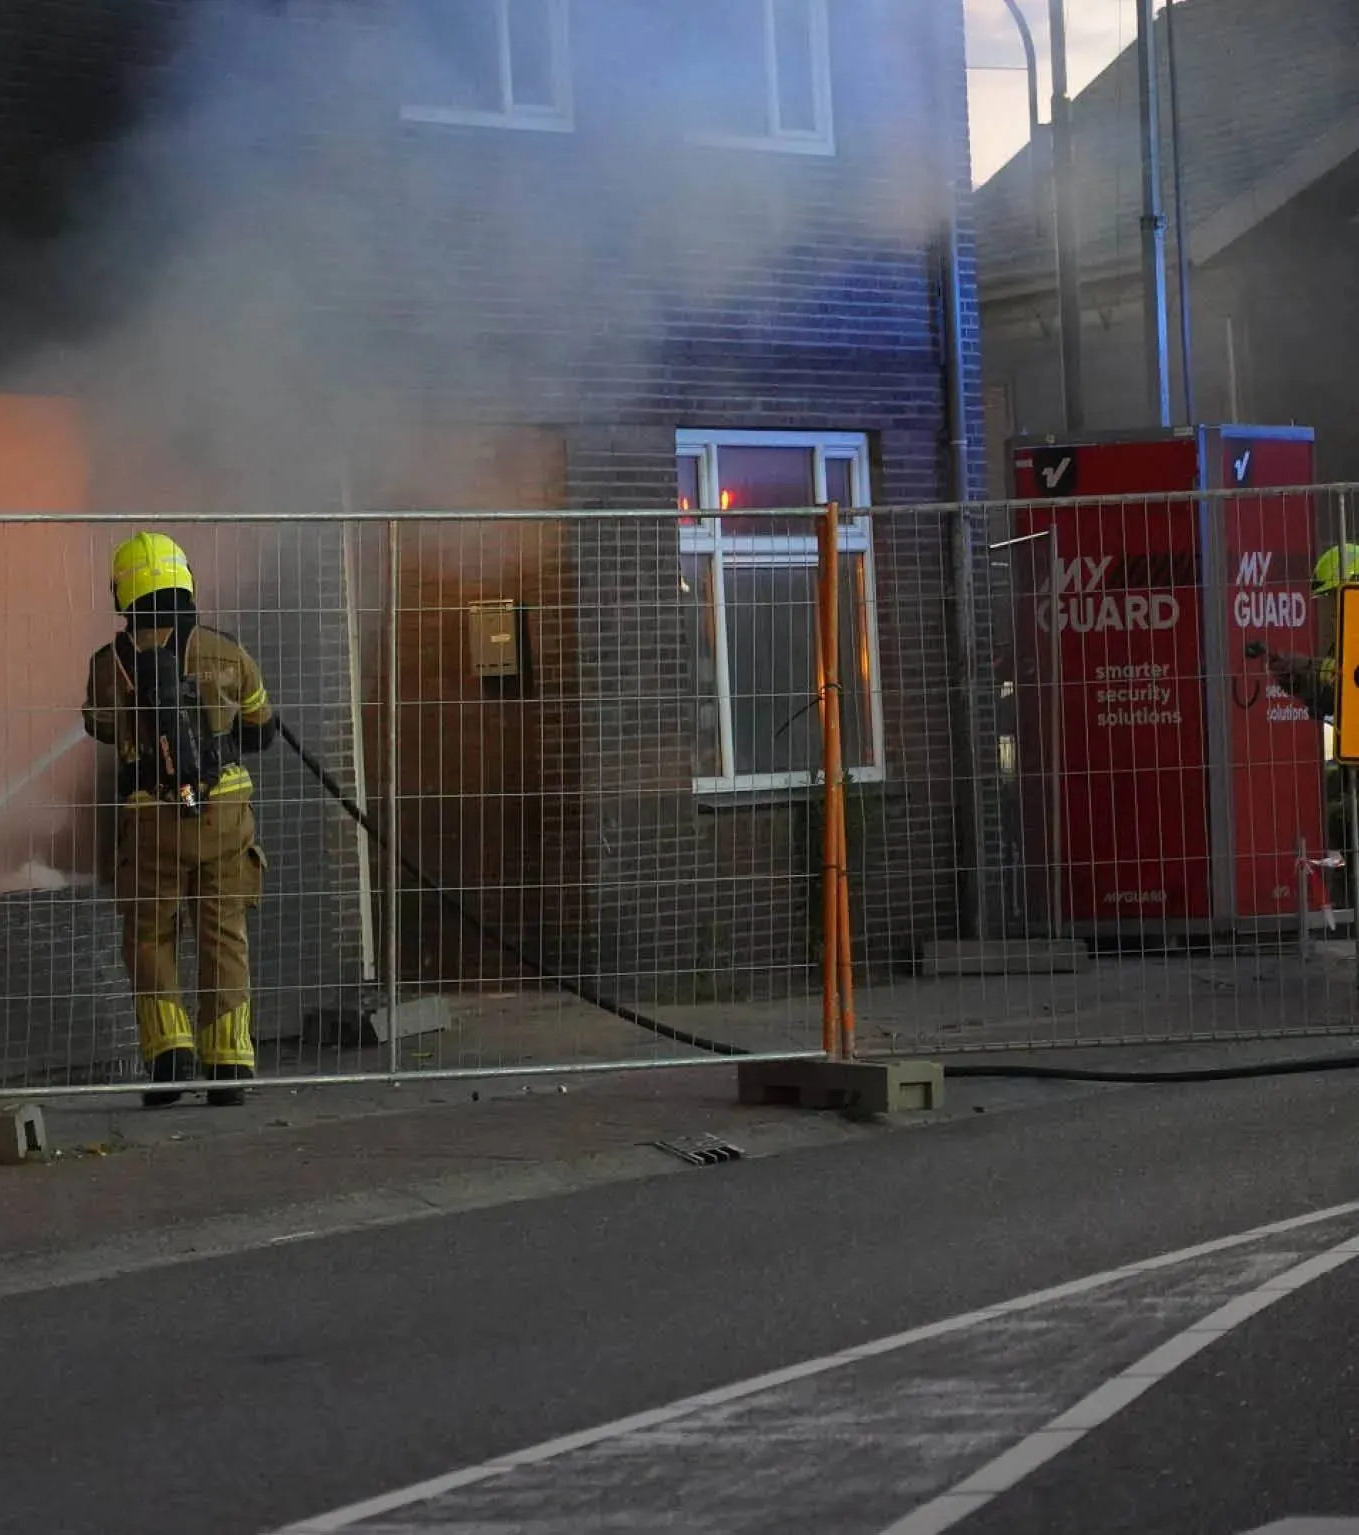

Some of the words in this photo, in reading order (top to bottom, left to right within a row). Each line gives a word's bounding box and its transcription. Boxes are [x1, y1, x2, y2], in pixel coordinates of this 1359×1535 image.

[1038, 555, 1114, 593] MY
[1236, 551, 1273, 586] MY
[1037, 595, 1180, 632] GUARD
[1234, 591, 1307, 629] GUARD
[1095, 662, 1170, 680] smarter
[1097, 682, 1171, 705] security
[1097, 706, 1183, 728] solutions
[1266, 703, 1310, 721] solutions
